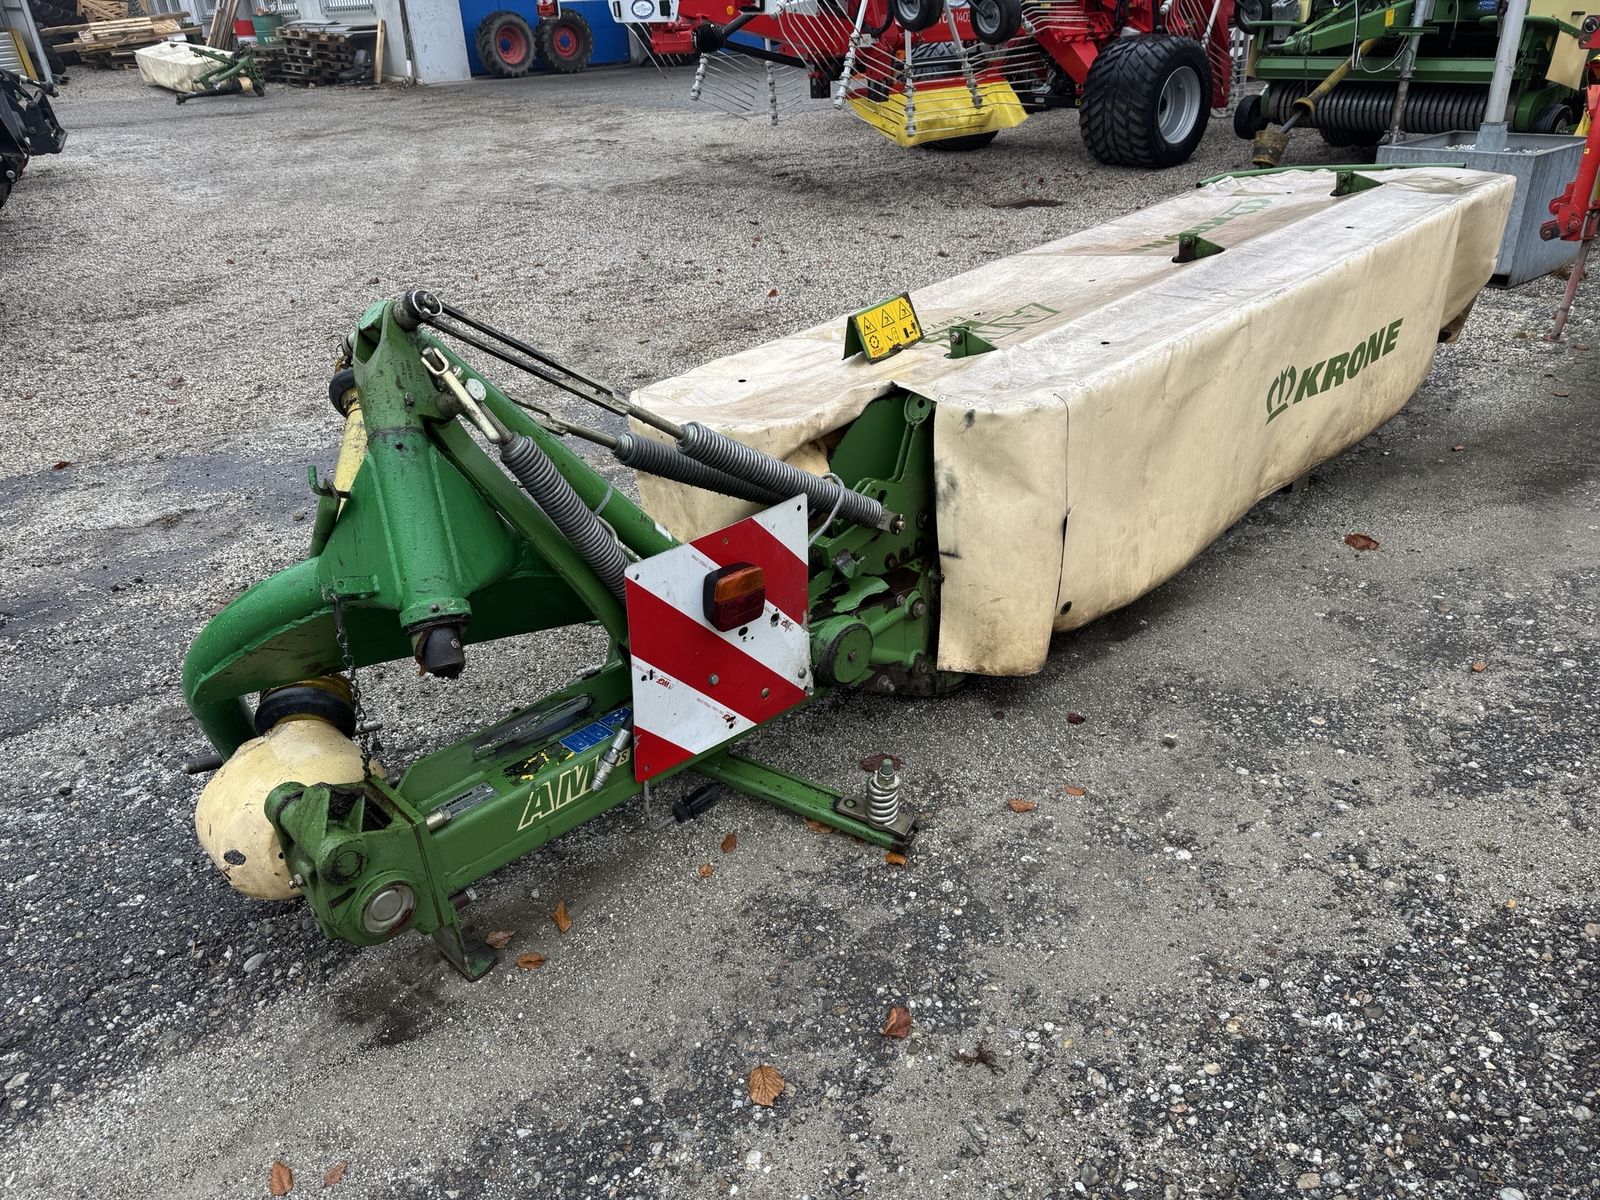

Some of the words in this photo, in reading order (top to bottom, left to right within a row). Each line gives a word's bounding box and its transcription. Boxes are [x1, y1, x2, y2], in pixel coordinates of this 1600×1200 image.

[872, 347, 884, 356] STOP
[1293, 317, 1403, 404] KRONE
[517, 755, 599, 832] AM
